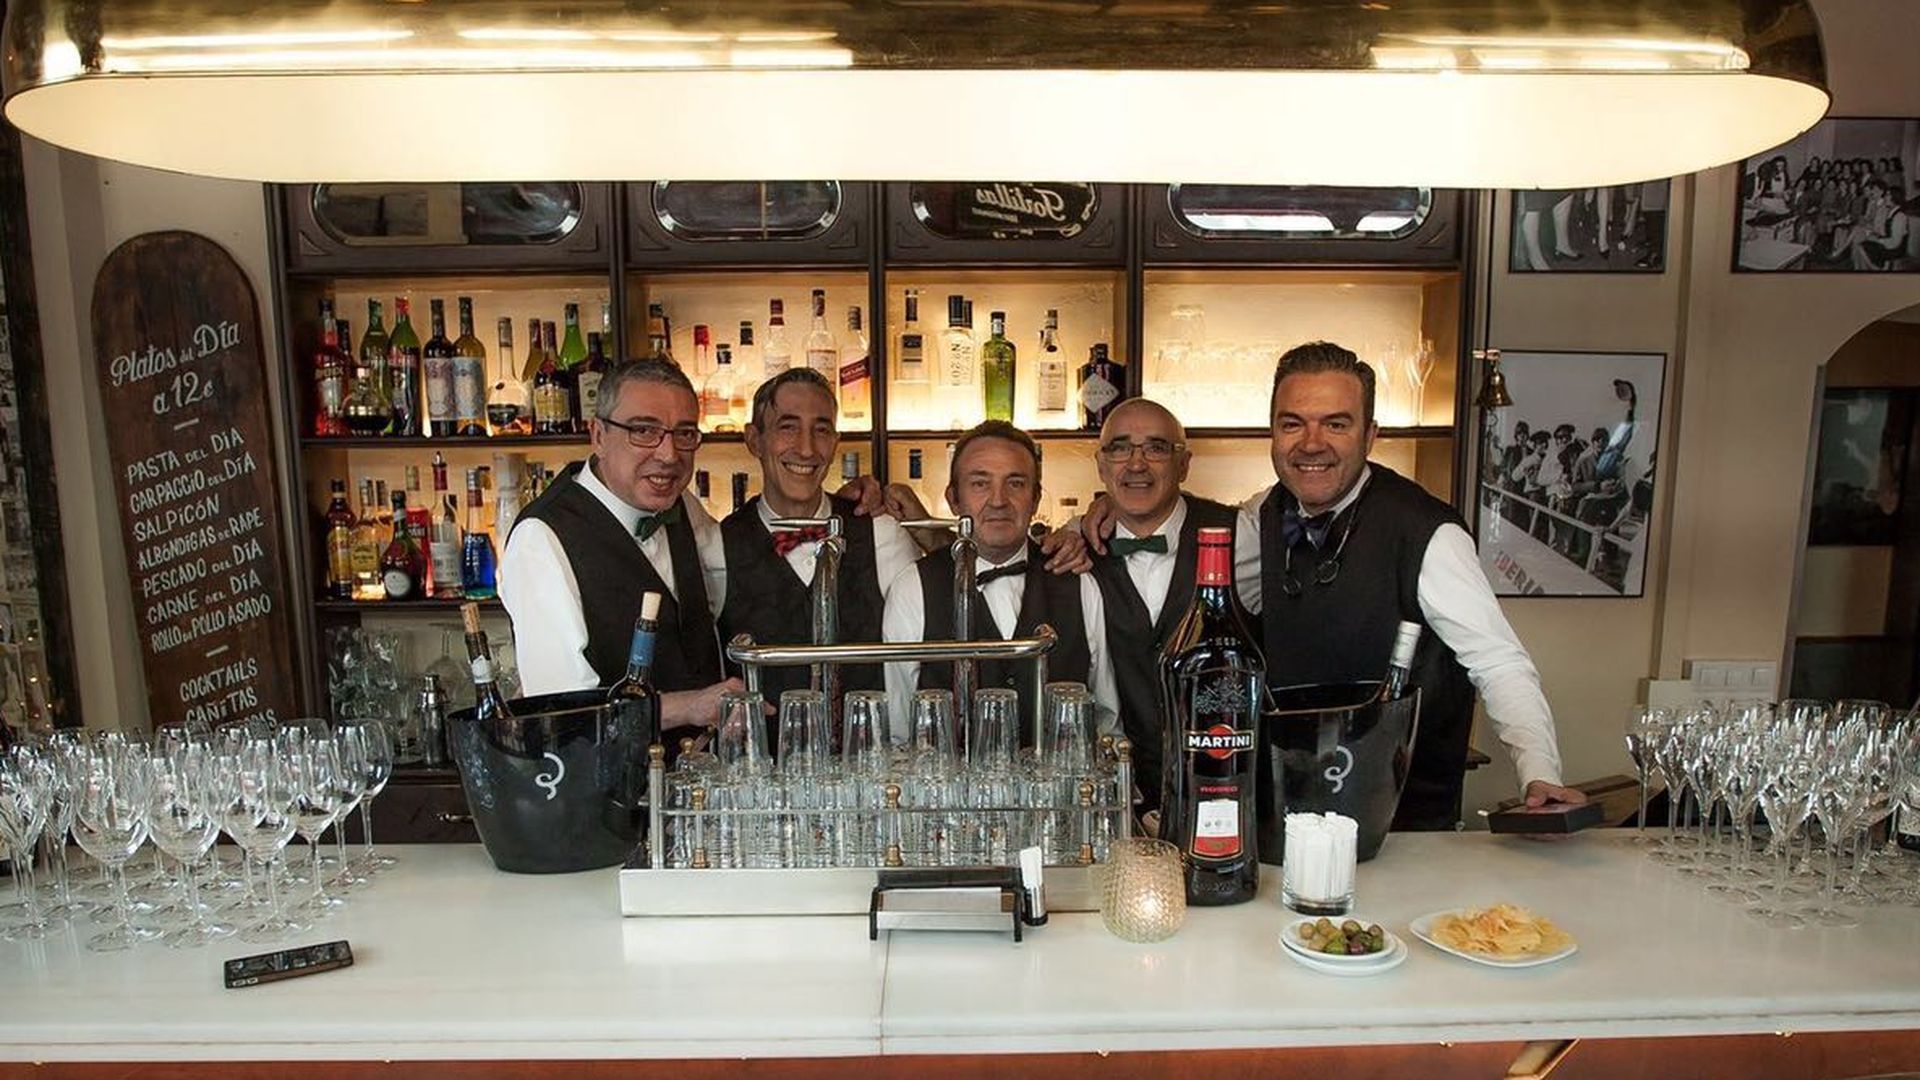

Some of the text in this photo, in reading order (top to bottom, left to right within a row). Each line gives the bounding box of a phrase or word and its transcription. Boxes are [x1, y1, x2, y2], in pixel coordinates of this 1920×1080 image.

[110, 344, 177, 387] Platos
[193, 320, 240, 358] Día
[153, 392, 171, 415] a
[127, 450, 181, 485] PASTA
[185, 449, 209, 463] DEL
[130, 469, 206, 514] CARPACCIO
[207, 473, 227, 487] DEL
[134, 493, 221, 542] SALPICÓN
[137, 507, 264, 571] ALBÓNDIGAS DE RAPE
[143, 557, 207, 599] PESCADO
[211, 559, 234, 574] DEL
[147, 588, 199, 624] CARNE
[204, 591, 227, 605] DEL
[151, 625, 182, 654] ROLLO
[190, 609, 226, 638] POLLO
[227, 593, 271, 626] ASADO
[180, 657, 258, 702] COCKTAILS
[1188, 735, 1250, 748] MARTINI
